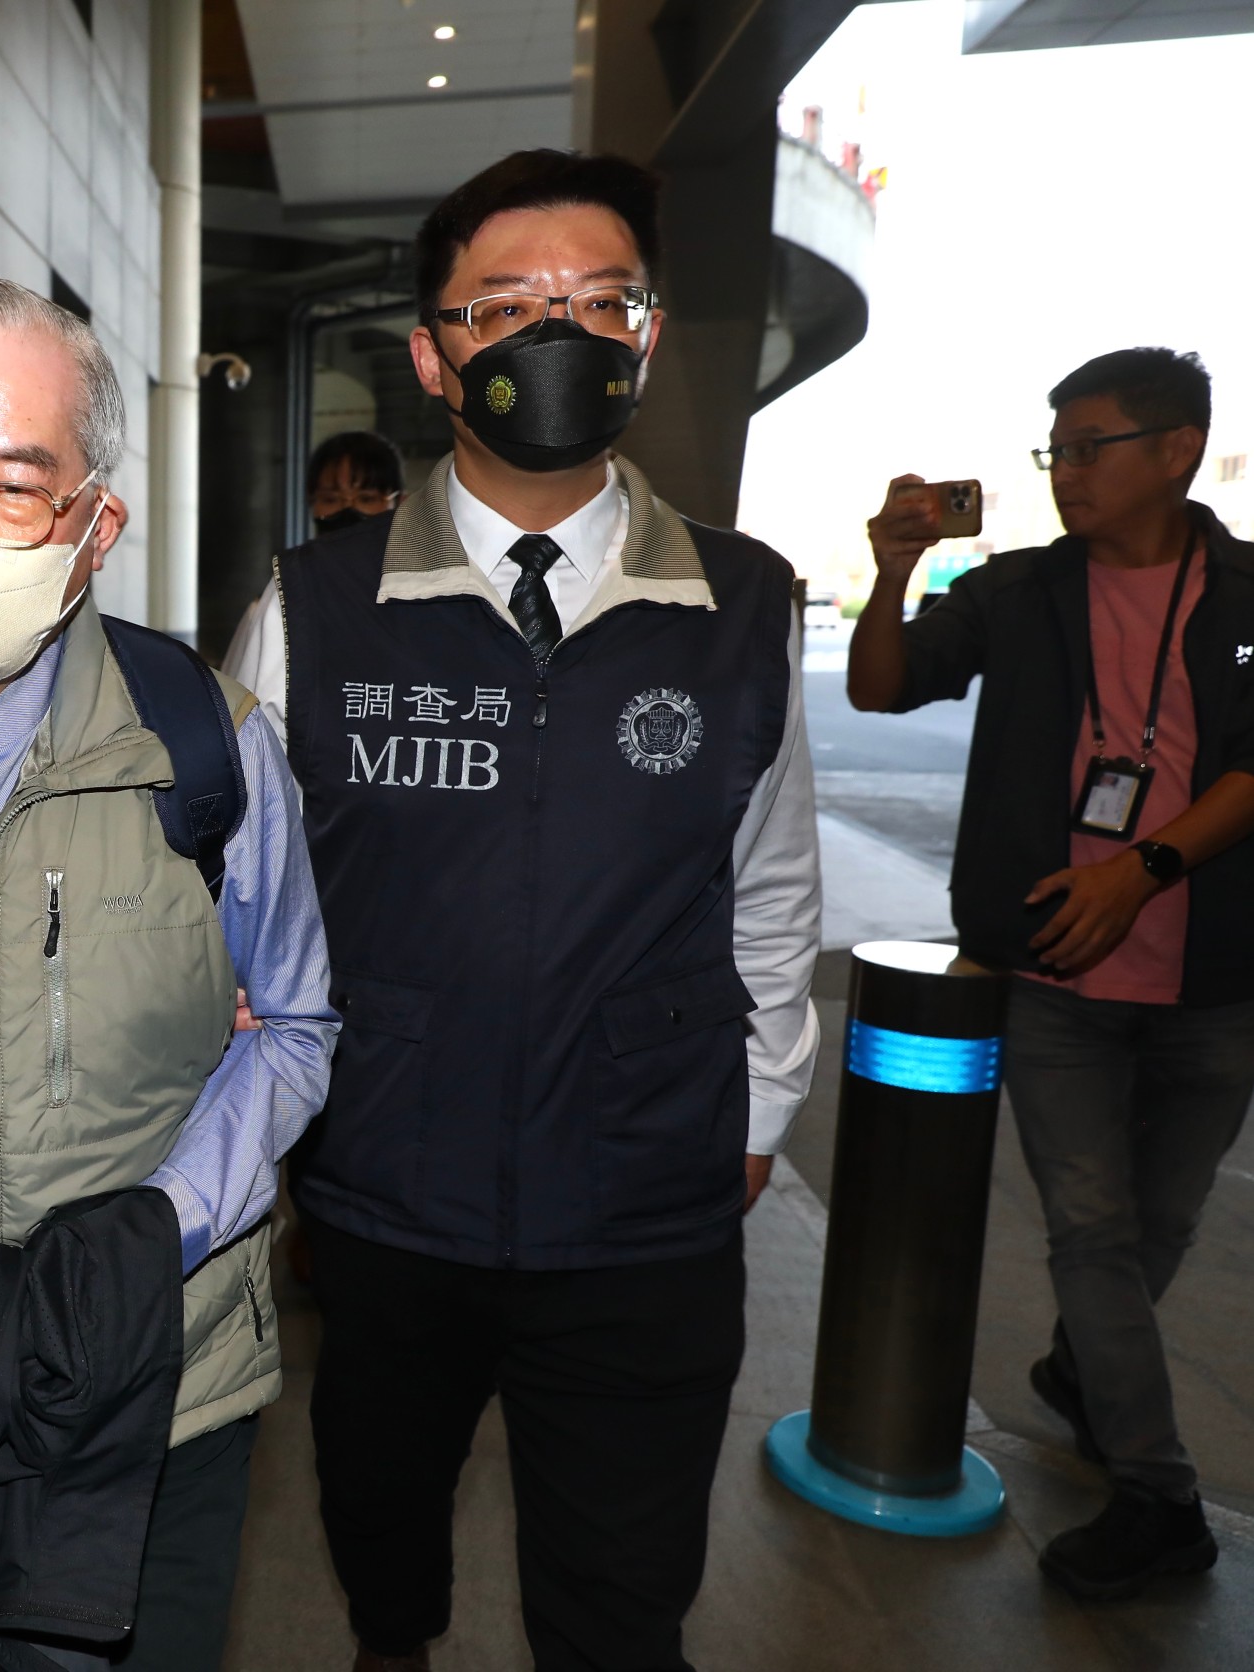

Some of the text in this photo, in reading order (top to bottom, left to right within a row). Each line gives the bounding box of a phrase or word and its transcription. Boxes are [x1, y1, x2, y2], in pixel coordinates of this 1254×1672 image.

[606, 379, 630, 396] MJIB
[342, 682, 512, 727] 調查局
[347, 734, 499, 791] MJIB
